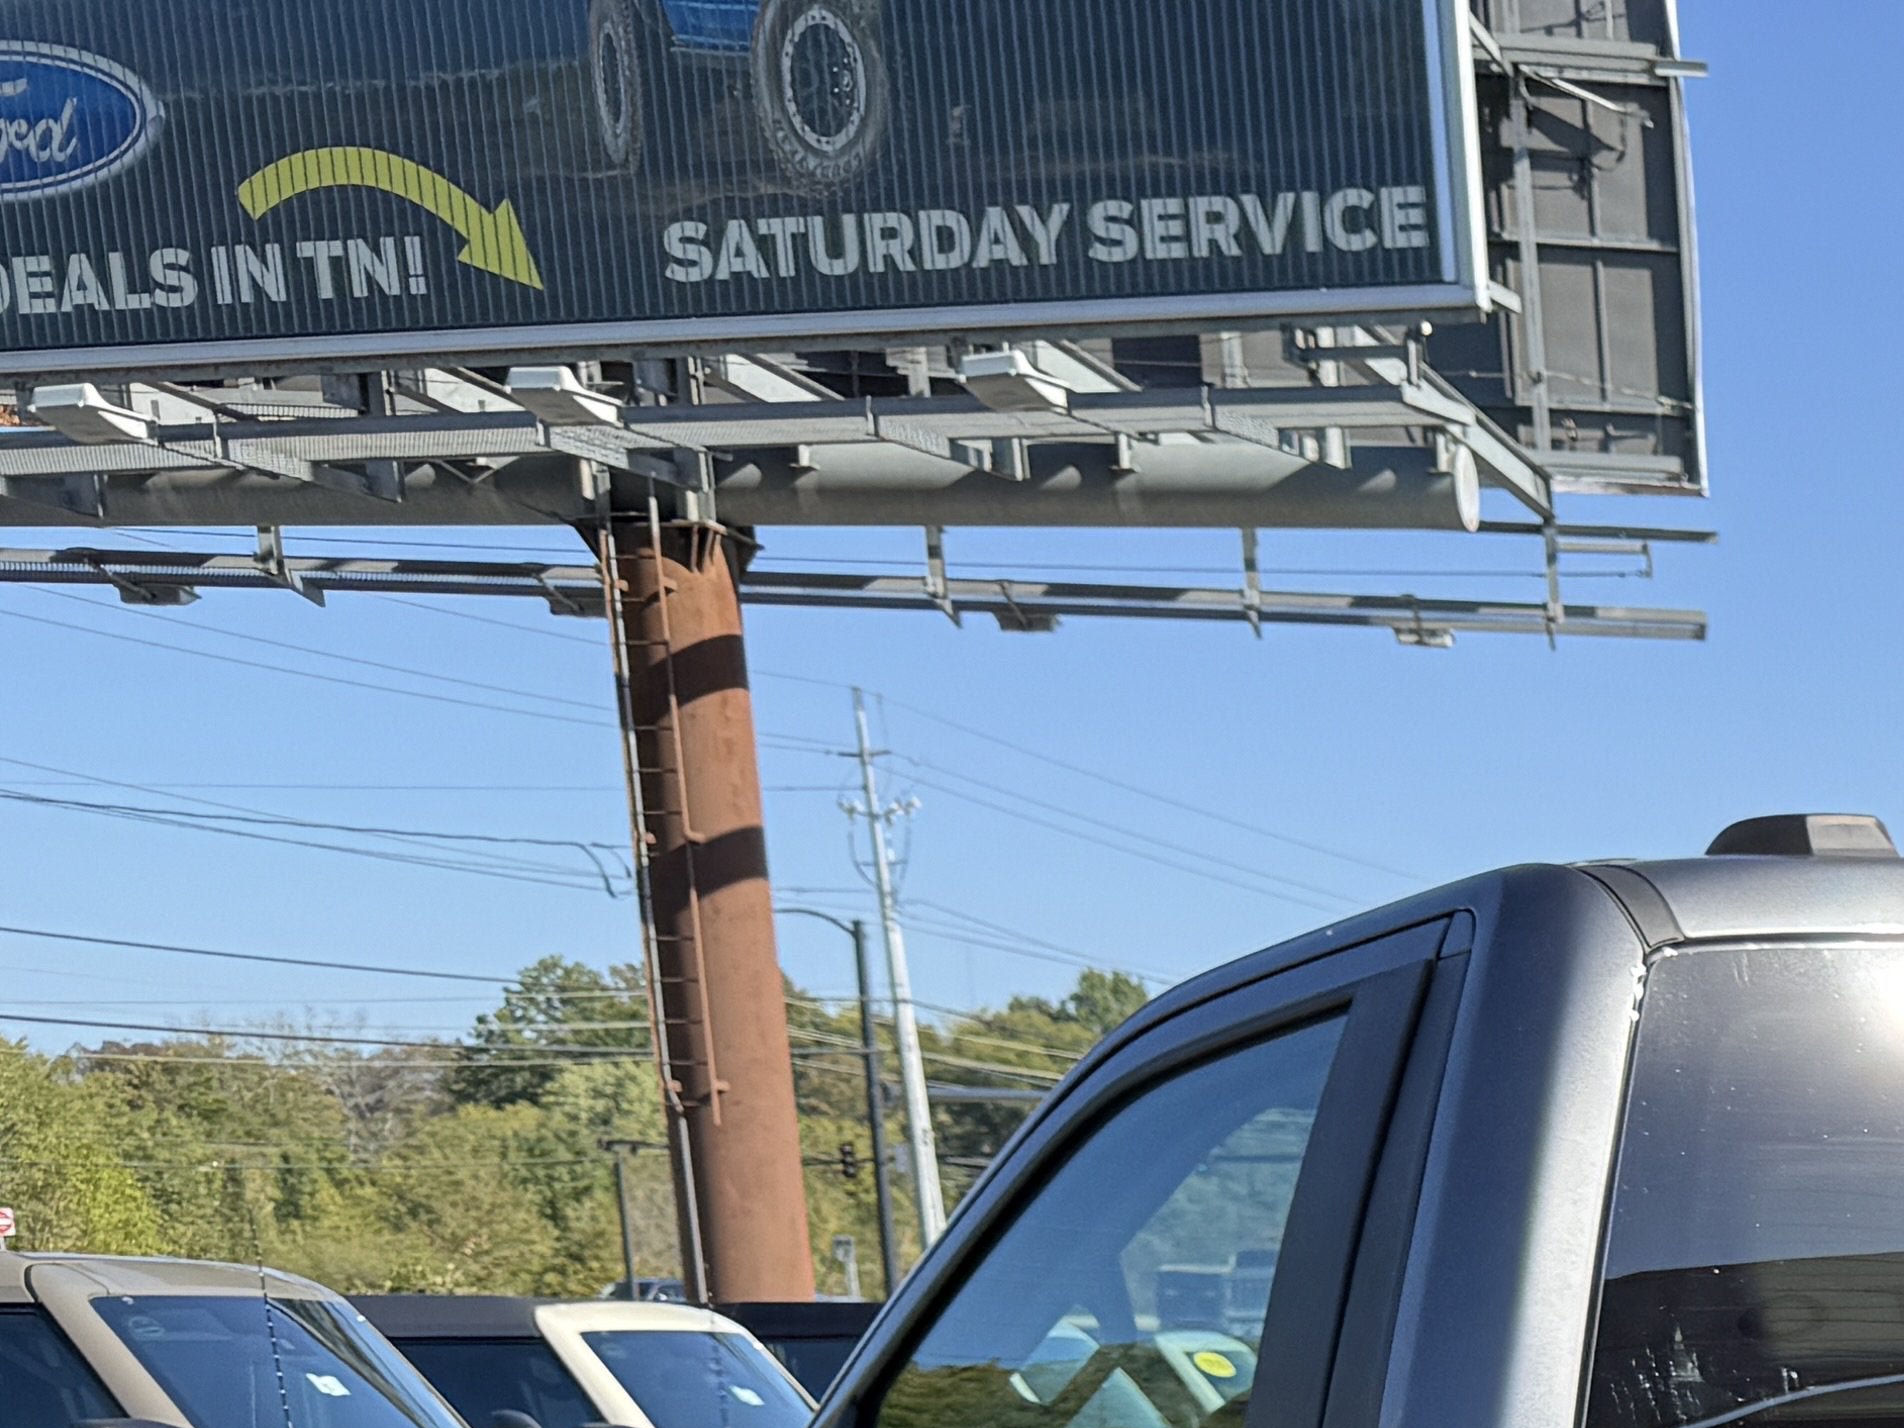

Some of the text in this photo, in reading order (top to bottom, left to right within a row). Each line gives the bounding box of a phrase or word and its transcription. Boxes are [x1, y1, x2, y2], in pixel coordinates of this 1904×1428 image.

[0, 236, 427, 315] EALS IN TN!
[663, 186, 1430, 283] SATURDAY SERVICE
